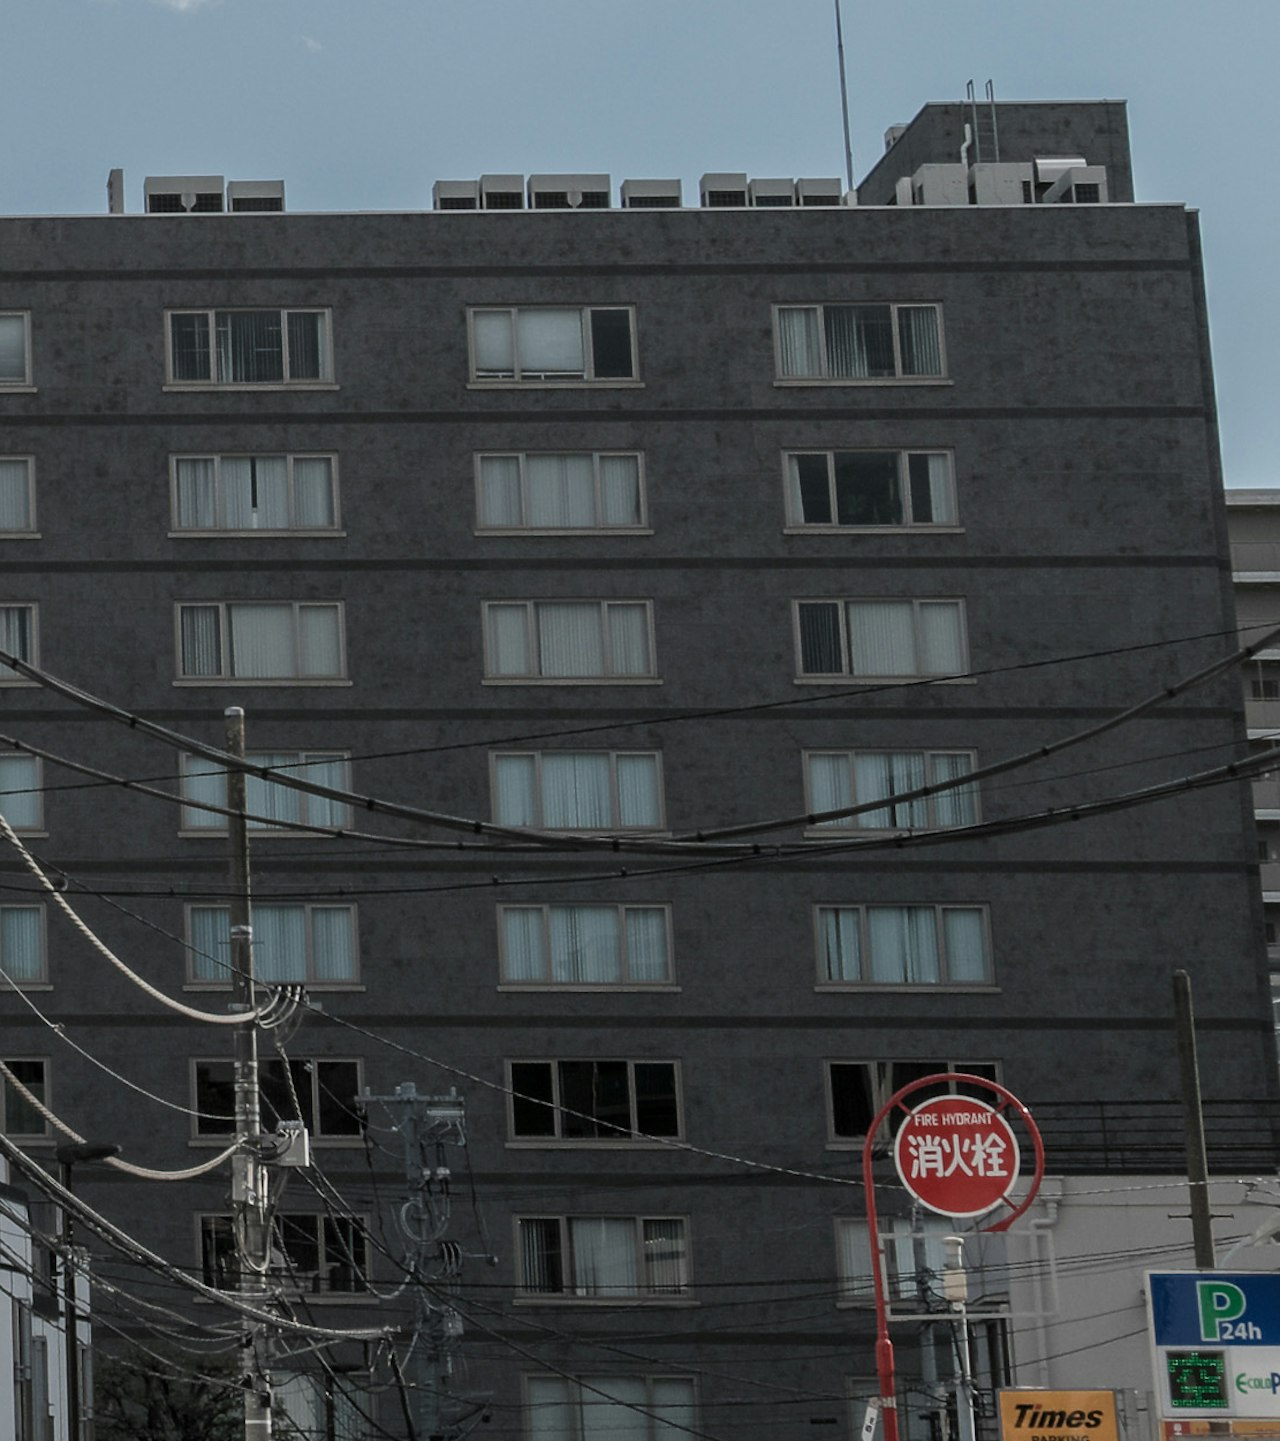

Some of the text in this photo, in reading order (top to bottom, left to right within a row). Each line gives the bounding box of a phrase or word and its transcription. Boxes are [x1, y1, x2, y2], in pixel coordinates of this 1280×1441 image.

[914, 1112, 993, 1126] FIRE HYDRANT
[907, 1133, 1008, 1178] 消火栓
[1196, 1280, 1246, 1341] P
[1221, 1321, 1262, 1340] 24h
[1014, 1403, 1104, 1429] Times
